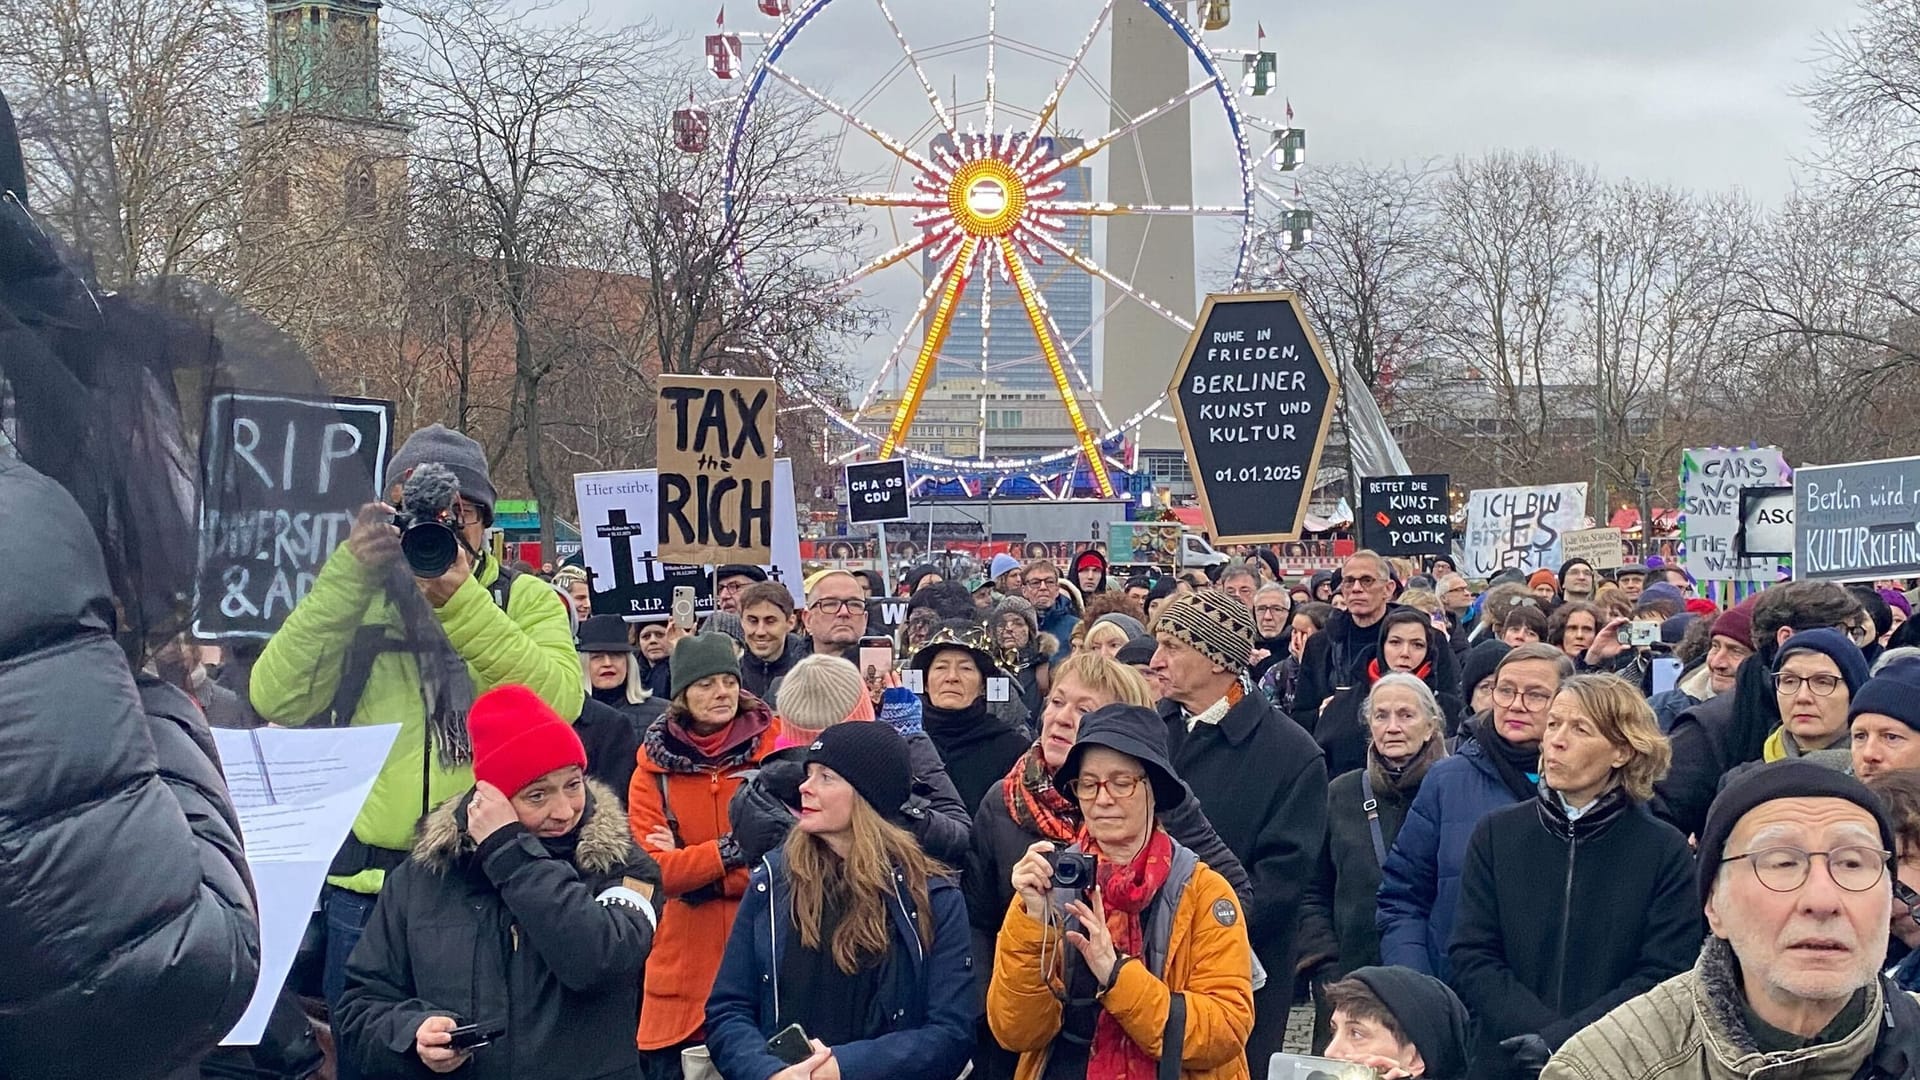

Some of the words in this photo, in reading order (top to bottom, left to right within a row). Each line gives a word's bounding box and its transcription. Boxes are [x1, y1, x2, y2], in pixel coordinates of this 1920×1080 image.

[1213, 331, 1244, 343] RUHE
[1257, 328, 1271, 341] IN
[1208, 345, 1299, 361] FRIEDEN,
[1192, 371, 1306, 394] BERLINER
[1200, 402, 1267, 420] KUNST
[1279, 402, 1311, 415] UND
[660, 386, 768, 460] TAX
[1210, 424, 1296, 443] KULTUR
[233, 418, 362, 494] RIP
[697, 454, 732, 472] the
[1702, 458, 1768, 479] CARS
[586, 483, 614, 496] Hier
[617, 481, 653, 494] stirbt,
[1370, 482, 1405, 494] RETTET
[1411, 482, 1428, 491] DIE
[1808, 478, 1861, 512] Berlin
[1871, 475, 1904, 506] wird
[864, 491, 890, 504] CDU
[1390, 495, 1440, 510] KUNST
[1484, 494, 1517, 517] ICH
[1526, 492, 1561, 514] BIN
[1685, 496, 1732, 516] SAVE
[658, 473, 771, 548] RICH
[1398, 515, 1422, 525] VOR
[1426, 514, 1448, 525] DER
[1389, 530, 1446, 547] POLITIK
[1475, 548, 1551, 573] WERT
[220, 565, 259, 618] &
[631, 599, 665, 611] R.I.P.
